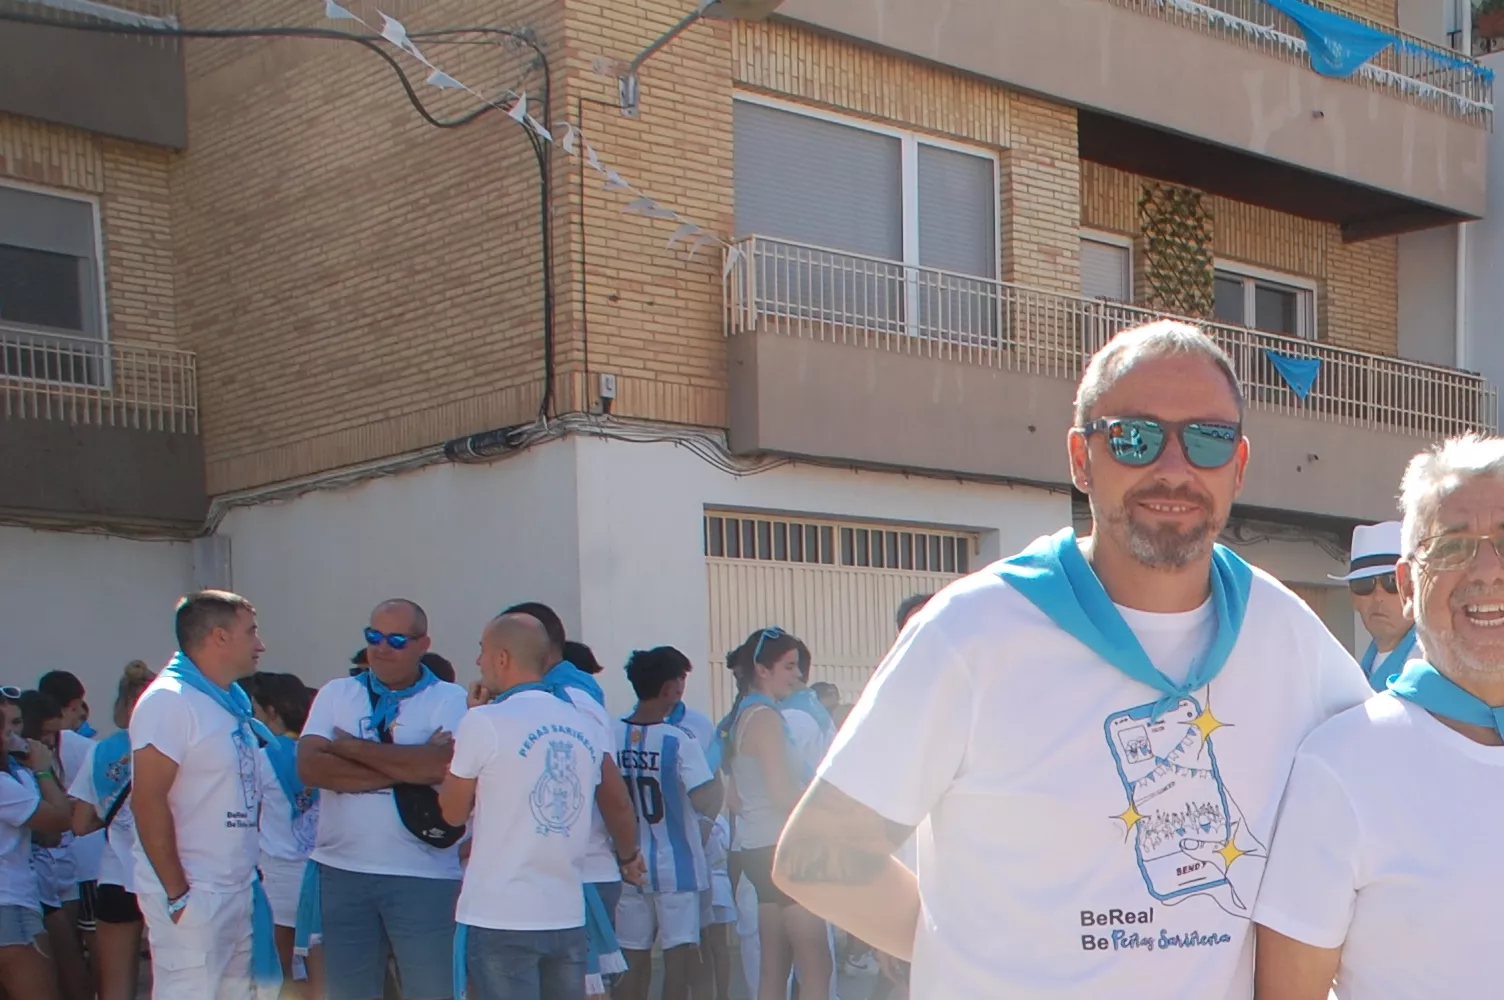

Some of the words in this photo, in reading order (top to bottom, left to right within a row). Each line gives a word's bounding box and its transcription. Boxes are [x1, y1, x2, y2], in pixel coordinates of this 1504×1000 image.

[617, 749, 660, 771] ESSI
[1176, 862, 1201, 876] SEND
[1080, 907, 1154, 926] BeReal
[1081, 934, 1109, 951] Be
[1111, 929, 1155, 951] Peñas
